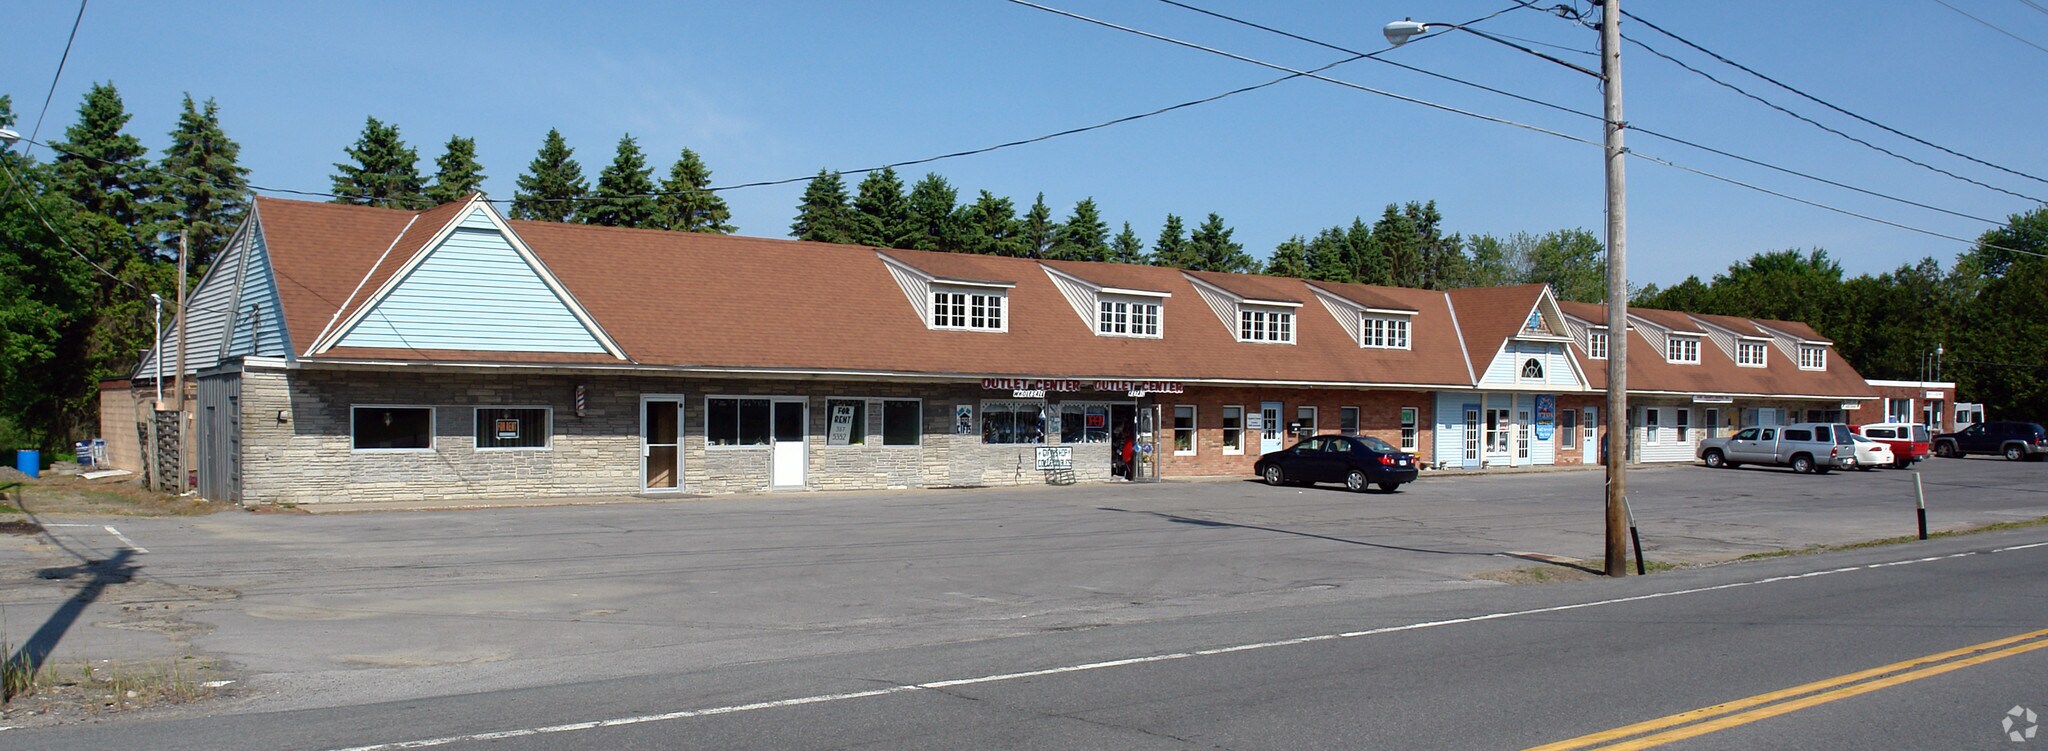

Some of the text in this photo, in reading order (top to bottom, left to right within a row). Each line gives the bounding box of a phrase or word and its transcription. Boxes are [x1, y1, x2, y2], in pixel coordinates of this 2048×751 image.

[982, 378, 1080, 392] OUTLET CENTER
[1094, 380, 1183, 393] OUTLET CENTER
[838, 407, 850, 415] FOR
[506, 422, 516, 431] RENT
